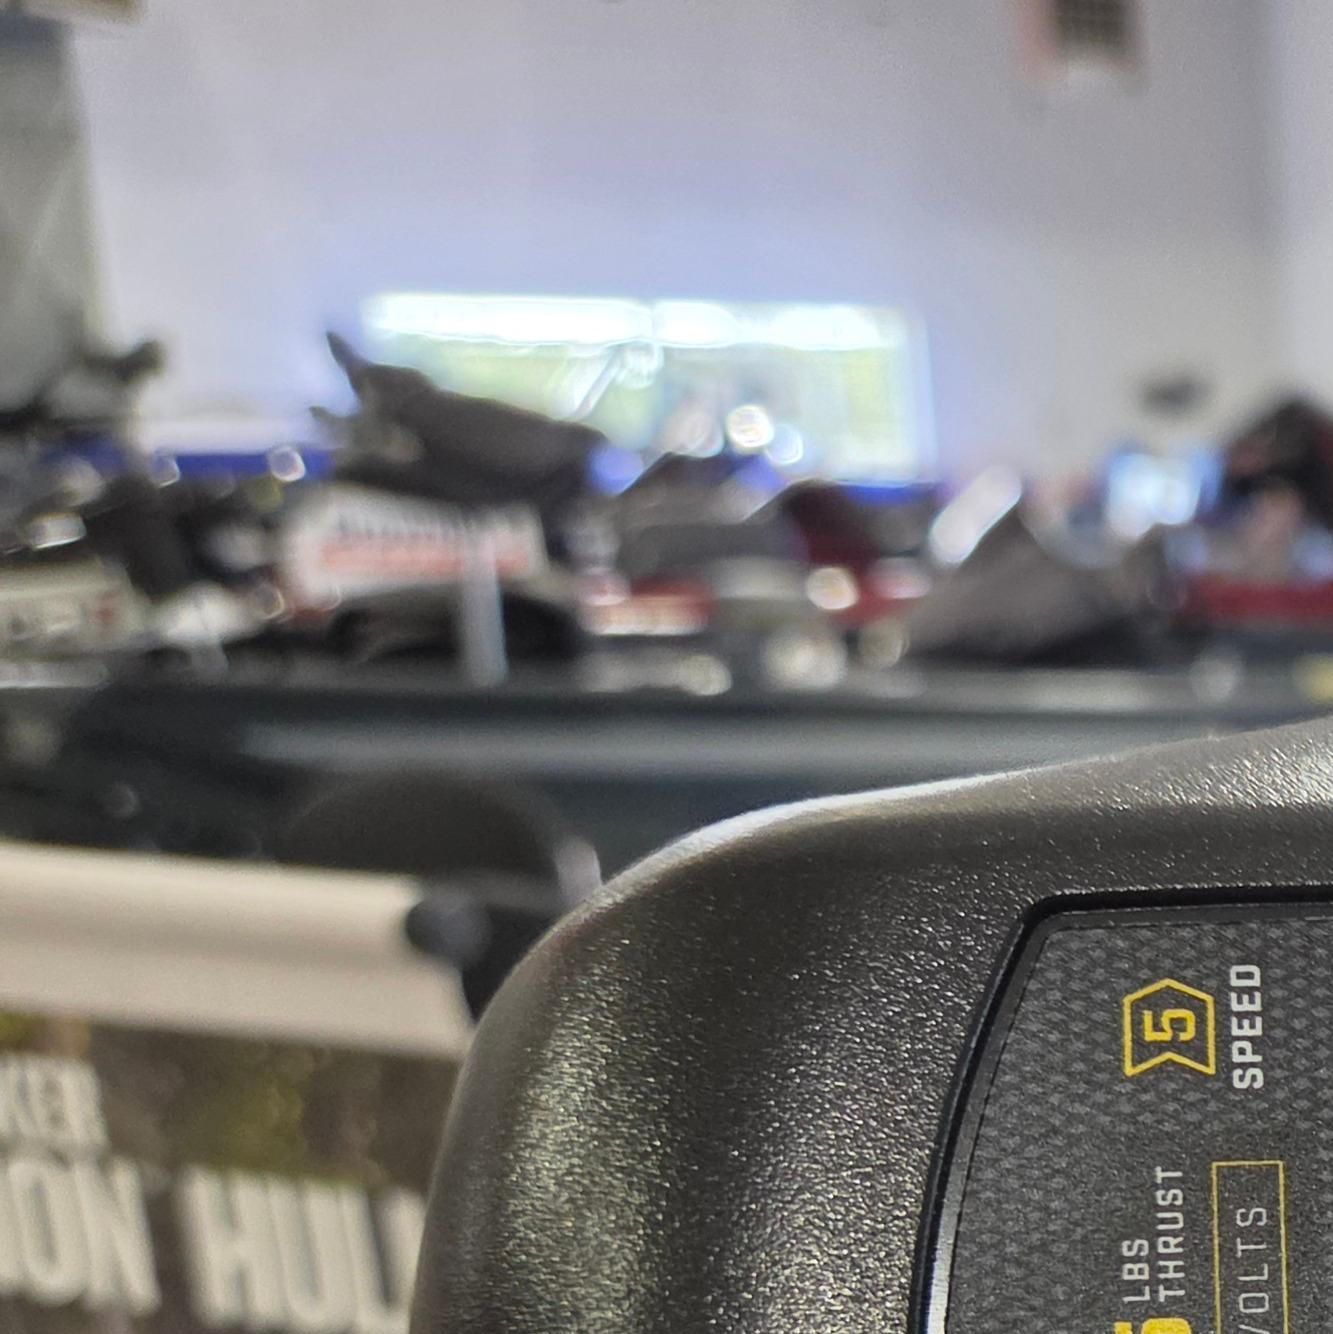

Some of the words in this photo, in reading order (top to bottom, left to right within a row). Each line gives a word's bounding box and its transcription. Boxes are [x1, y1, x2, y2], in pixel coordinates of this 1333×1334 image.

[1141, 1008, 1197, 1043] 5
[1230, 964, 1265, 1090] SPEED
[1121, 1238, 1151, 1303] LBS
[1156, 1165, 1187, 1303] THRUST
